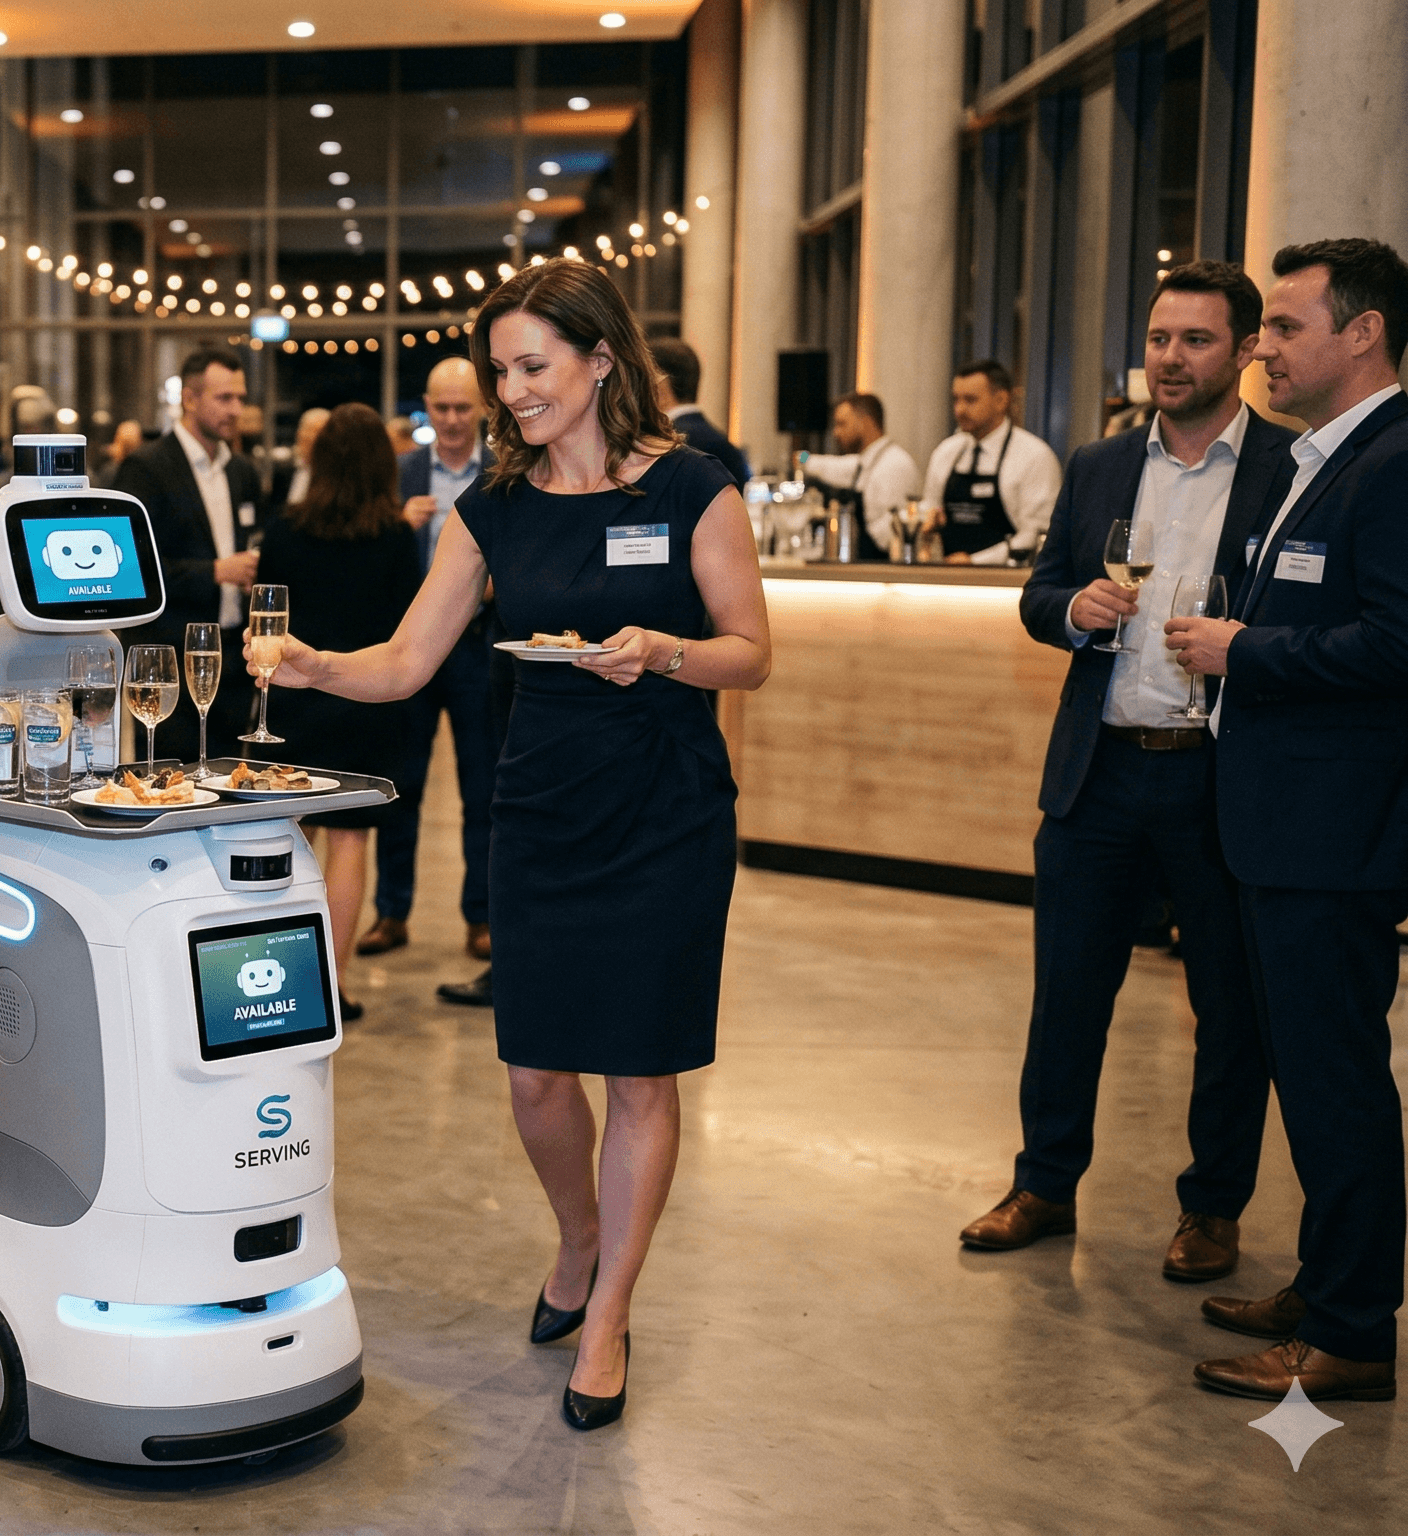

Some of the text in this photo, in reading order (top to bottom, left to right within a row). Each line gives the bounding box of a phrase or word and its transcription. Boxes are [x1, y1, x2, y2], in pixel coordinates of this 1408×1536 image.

[68, 584, 113, 596] AVAILABLE
[233, 998, 297, 1021] AVAILABLE
[234, 1139, 310, 1169] SERVING
